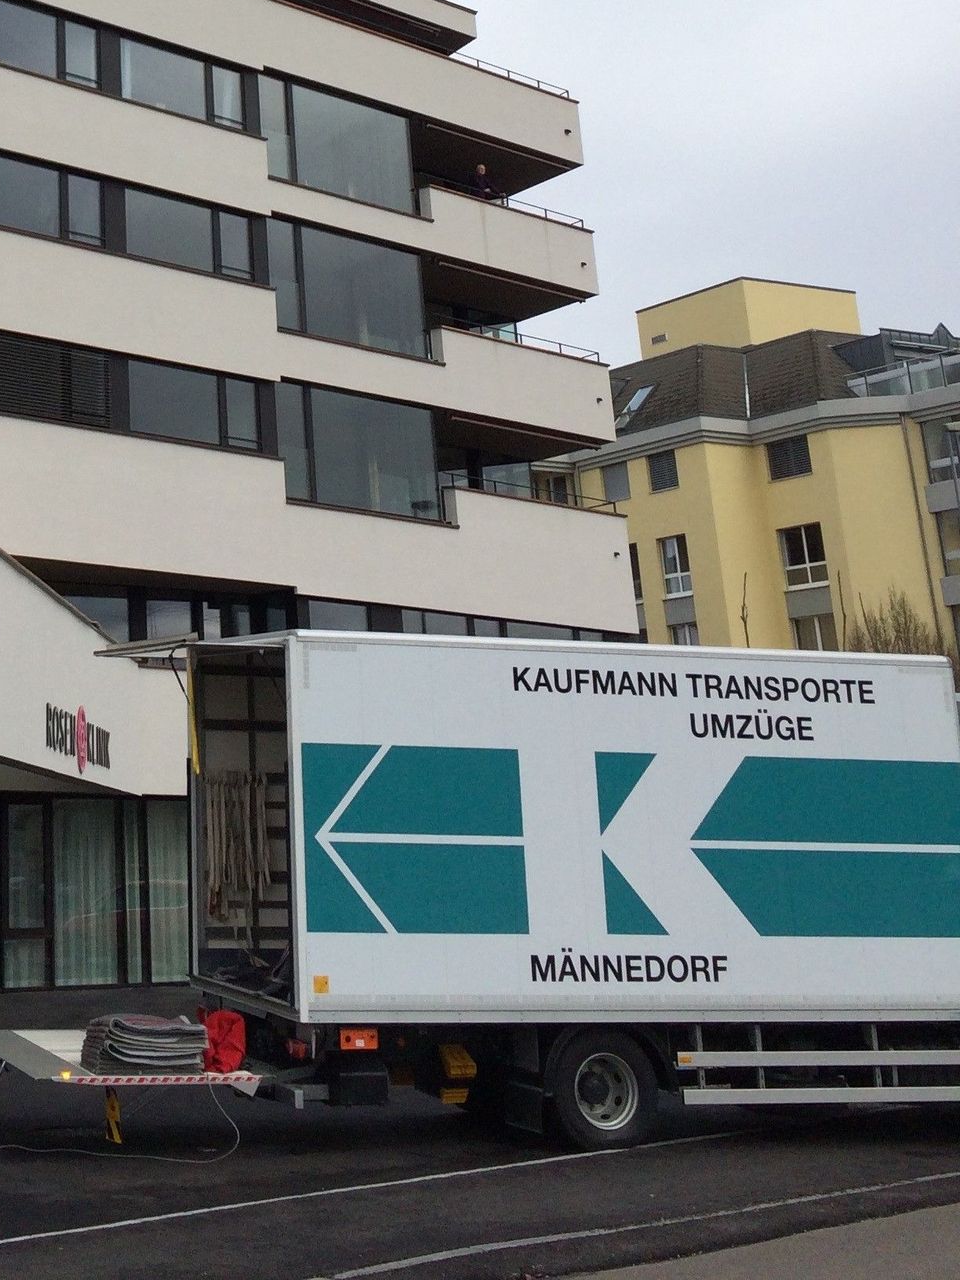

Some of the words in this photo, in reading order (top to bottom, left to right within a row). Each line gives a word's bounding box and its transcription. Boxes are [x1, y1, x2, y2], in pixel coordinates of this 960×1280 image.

[512, 667, 678, 698] KAUFMANN
[686, 673, 875, 705] TRANSPORTE
[689, 709, 814, 741] UMZÜGE
[530, 947, 728, 982] MÄNNEDORF
